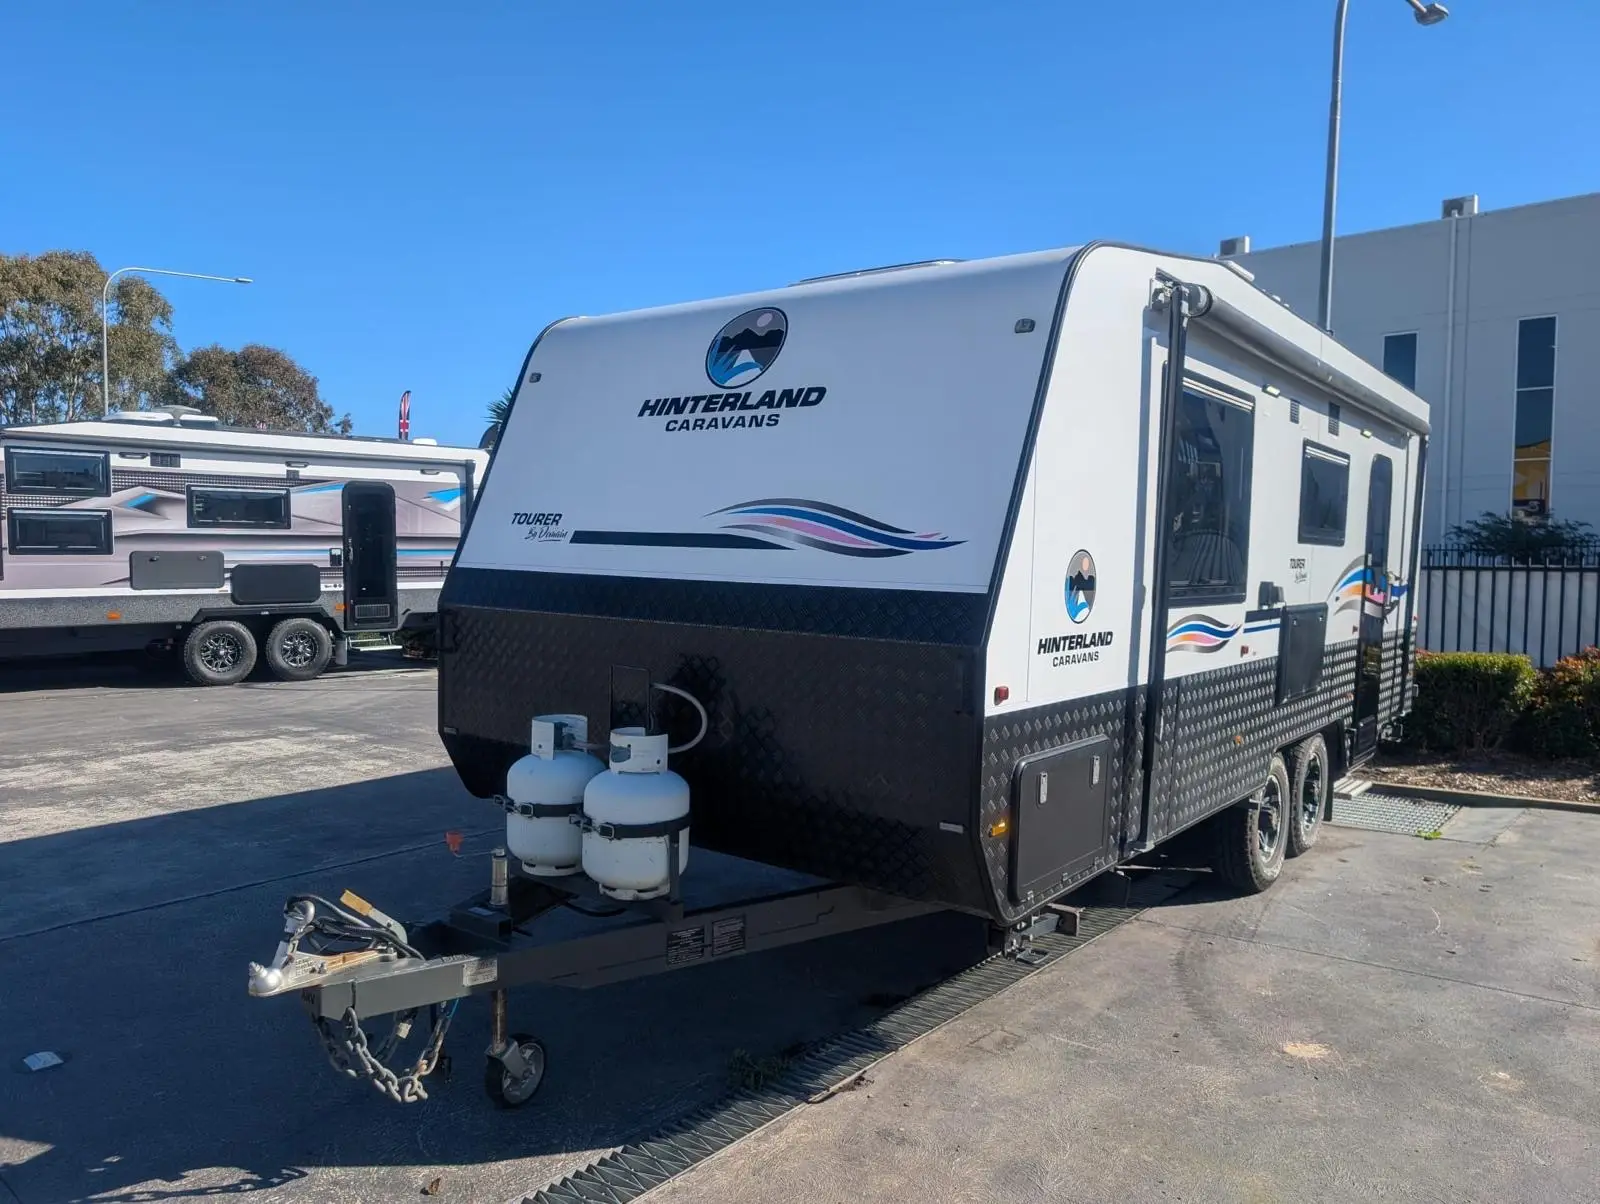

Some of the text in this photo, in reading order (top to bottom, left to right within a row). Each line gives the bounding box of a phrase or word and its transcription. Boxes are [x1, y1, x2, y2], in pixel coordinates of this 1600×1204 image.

[637, 386, 827, 418] HINTERLAND
[665, 413, 780, 432] CARAVANS
[511, 512, 563, 526] TOURER
[1037, 631, 1113, 655] HINTERLAND
[1052, 651, 1099, 668] CARAVANS
